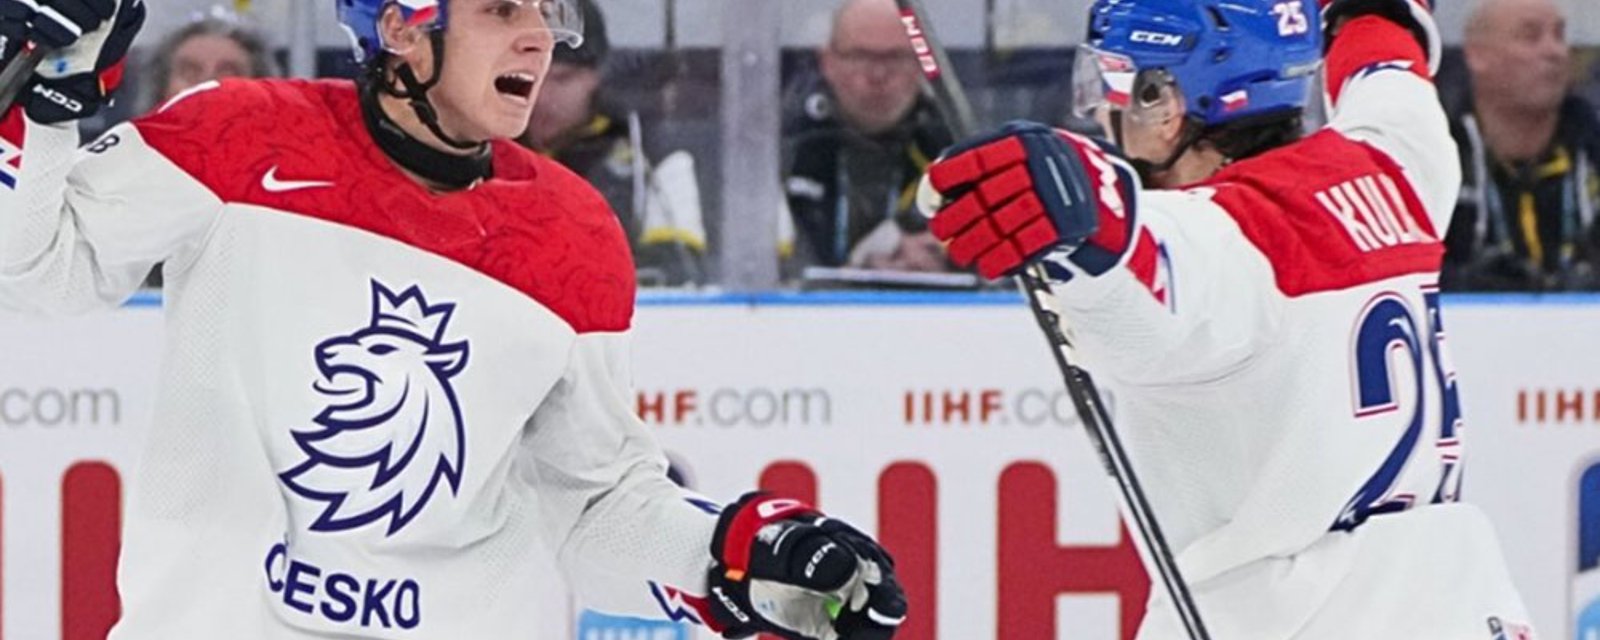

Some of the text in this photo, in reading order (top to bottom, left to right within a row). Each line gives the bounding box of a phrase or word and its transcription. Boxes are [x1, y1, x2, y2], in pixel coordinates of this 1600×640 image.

[1273, 1, 1308, 36] 25
[1129, 30, 1182, 45] CCM
[32, 83, 83, 112] CCM
[804, 541, 837, 578] CCM
[712, 587, 749, 622] CCM
